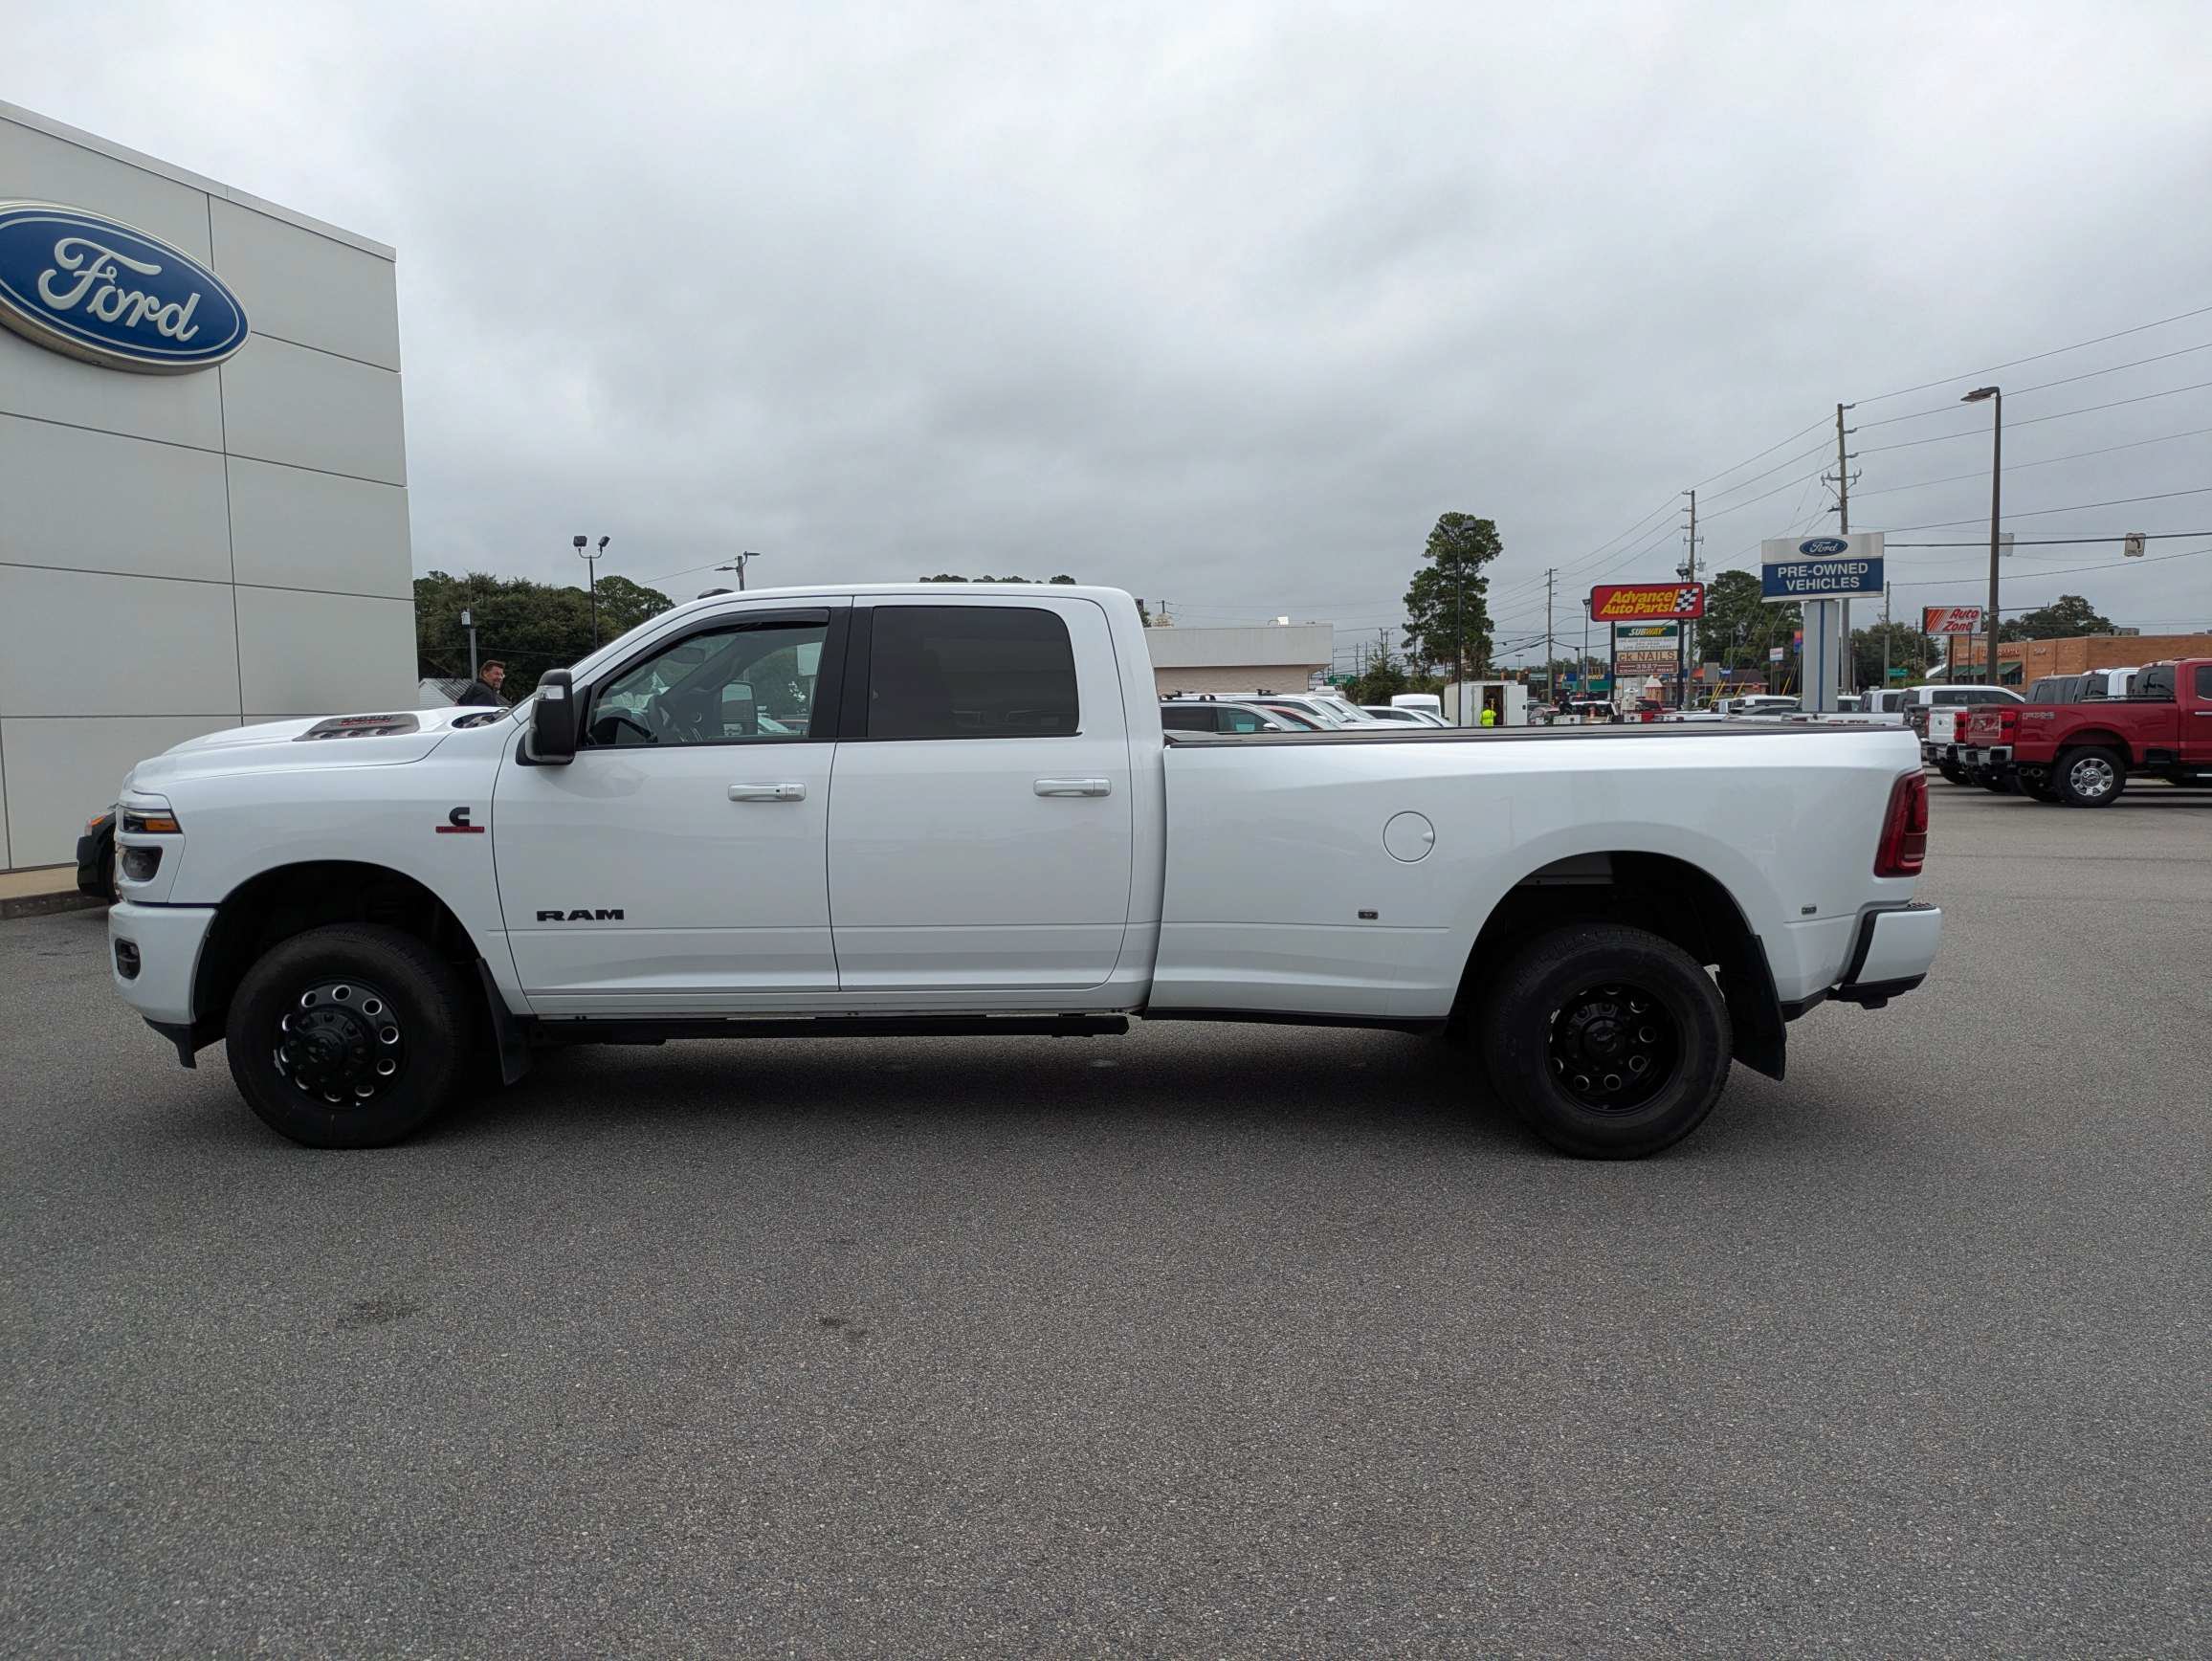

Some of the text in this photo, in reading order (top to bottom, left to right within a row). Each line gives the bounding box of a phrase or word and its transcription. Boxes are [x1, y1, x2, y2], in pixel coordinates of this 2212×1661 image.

[37, 237, 201, 342] Ford
[1809, 541, 1838, 553] Ford
[1778, 563, 1869, 578] PRE-OWNED
[1785, 576, 1860, 591] VEHICLES
[1609, 590, 1672, 604] Advance
[1601, 603, 1670, 614] Auto Parts
[1949, 608, 1980, 619] Auto
[1637, 651, 1675, 660] NAILS
[537, 909, 624, 921] RAM
